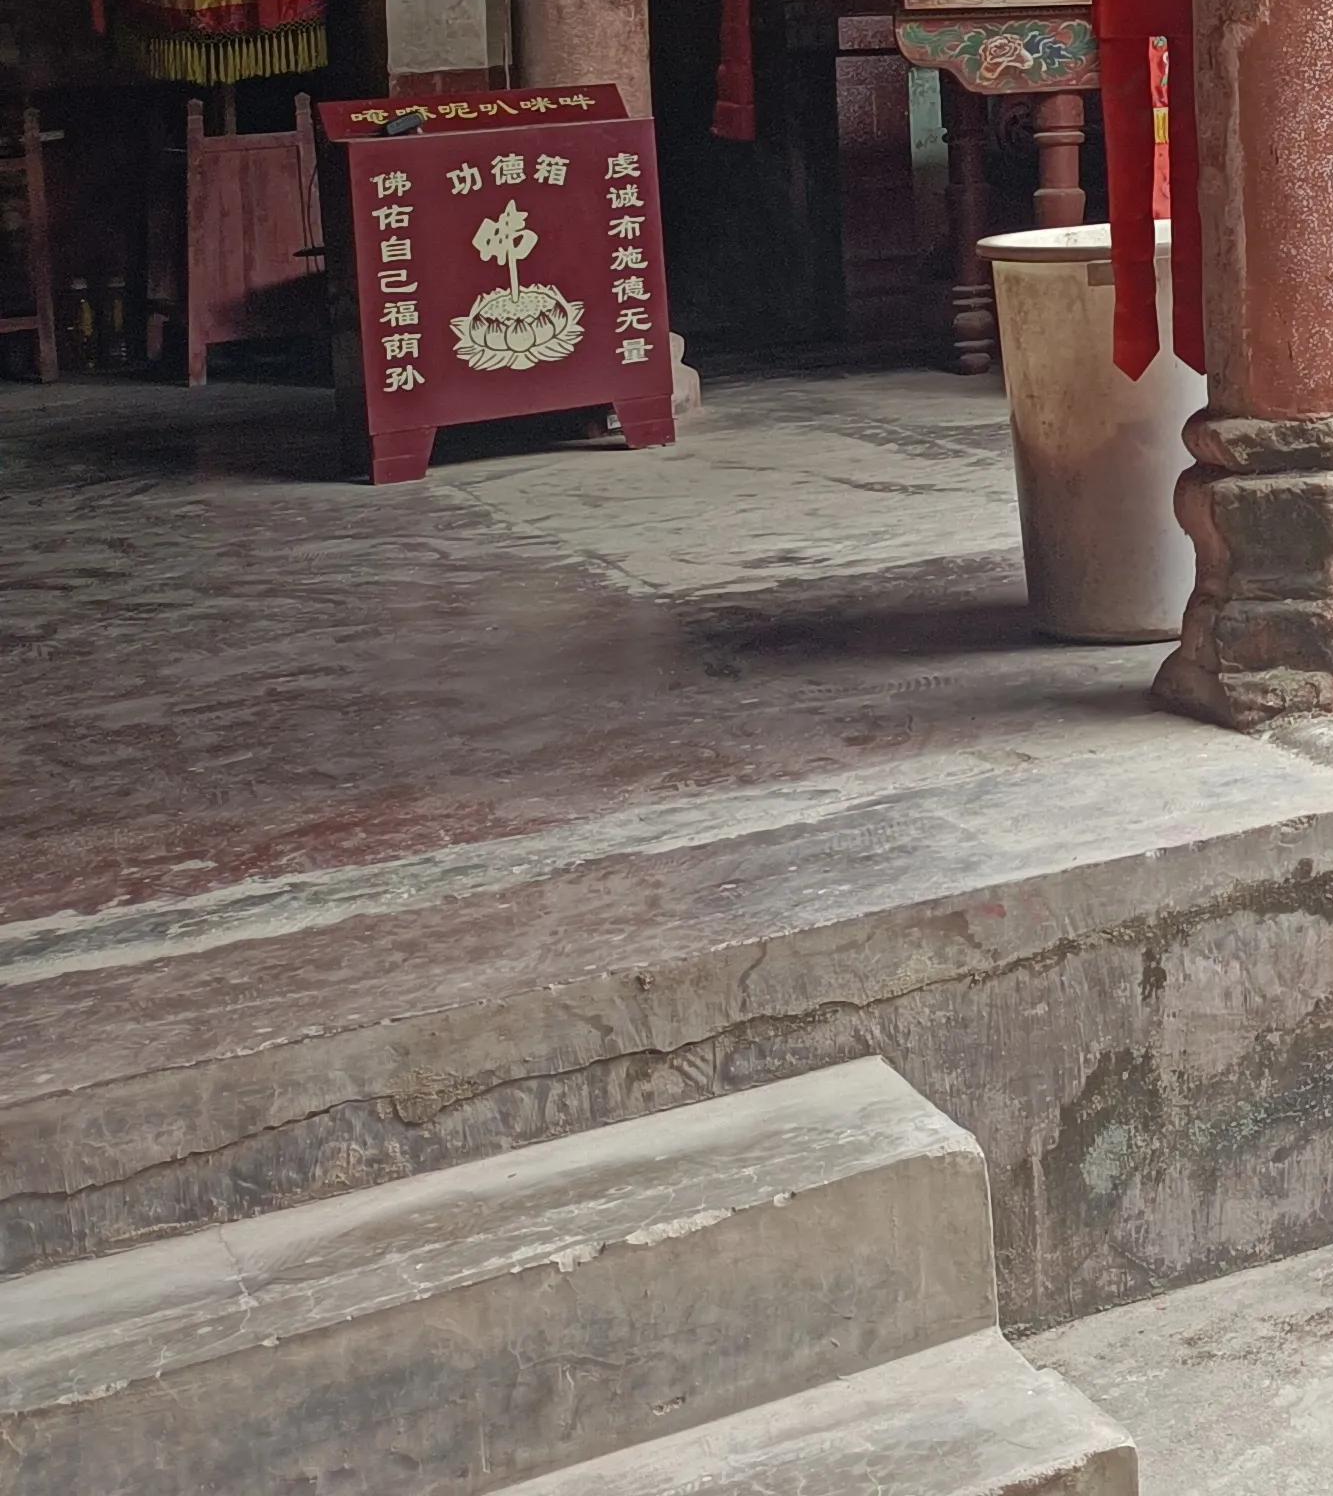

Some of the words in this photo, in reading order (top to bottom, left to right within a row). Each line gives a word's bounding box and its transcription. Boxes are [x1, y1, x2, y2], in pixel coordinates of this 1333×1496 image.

[446, 152, 570, 195] 功德箱
[604, 152, 654, 365] 虔诚布施德无量
[371, 170, 426, 393] 佛佑自己福荫孙
